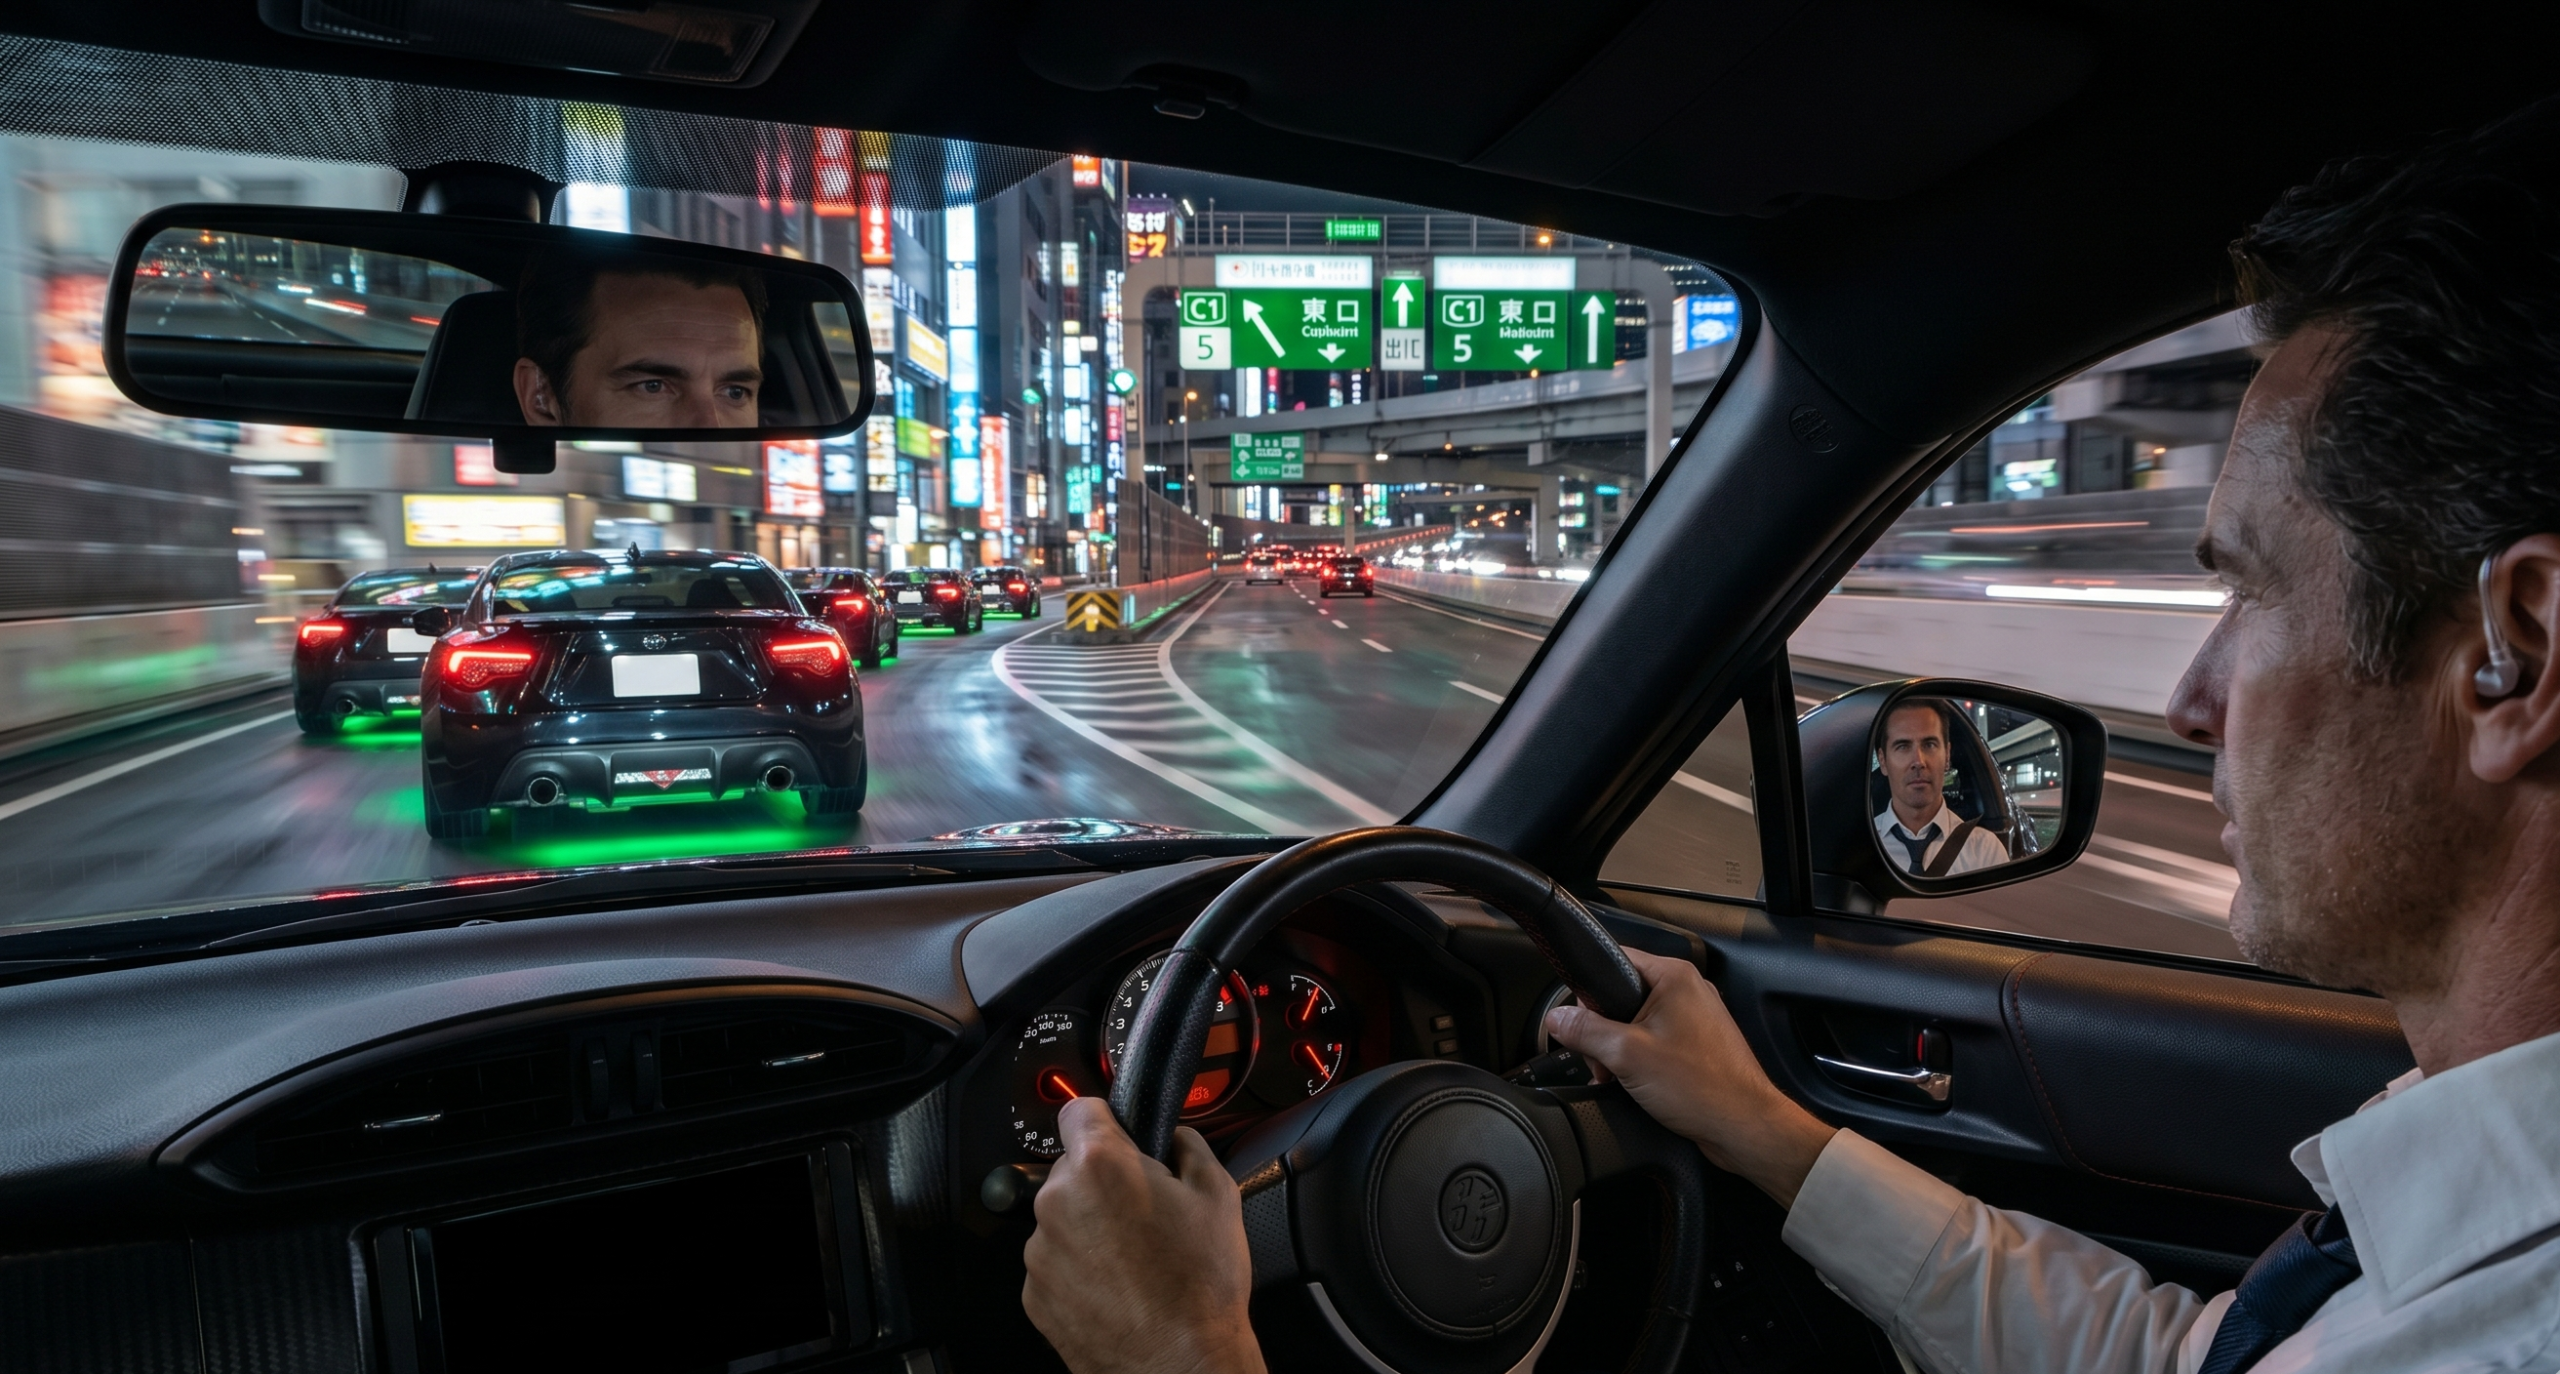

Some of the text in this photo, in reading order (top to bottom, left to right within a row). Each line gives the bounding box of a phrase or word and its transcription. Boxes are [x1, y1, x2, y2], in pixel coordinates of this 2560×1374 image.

[1190, 297, 1218, 320] C1
[1302, 297, 1359, 323] 東口
[1448, 300, 1476, 322] C1
[1499, 298, 1556, 324] 東口
[1197, 334, 1214, 360] 5
[1453, 334, 1472, 363] 5
[1141, 980, 1149, 991] 5
[1216, 1001, 1224, 1012] 3
[1116, 1018, 1125, 1030] 3
[1117, 1043, 1125, 1054] 2
[1025, 1131, 1038, 1141] 60
